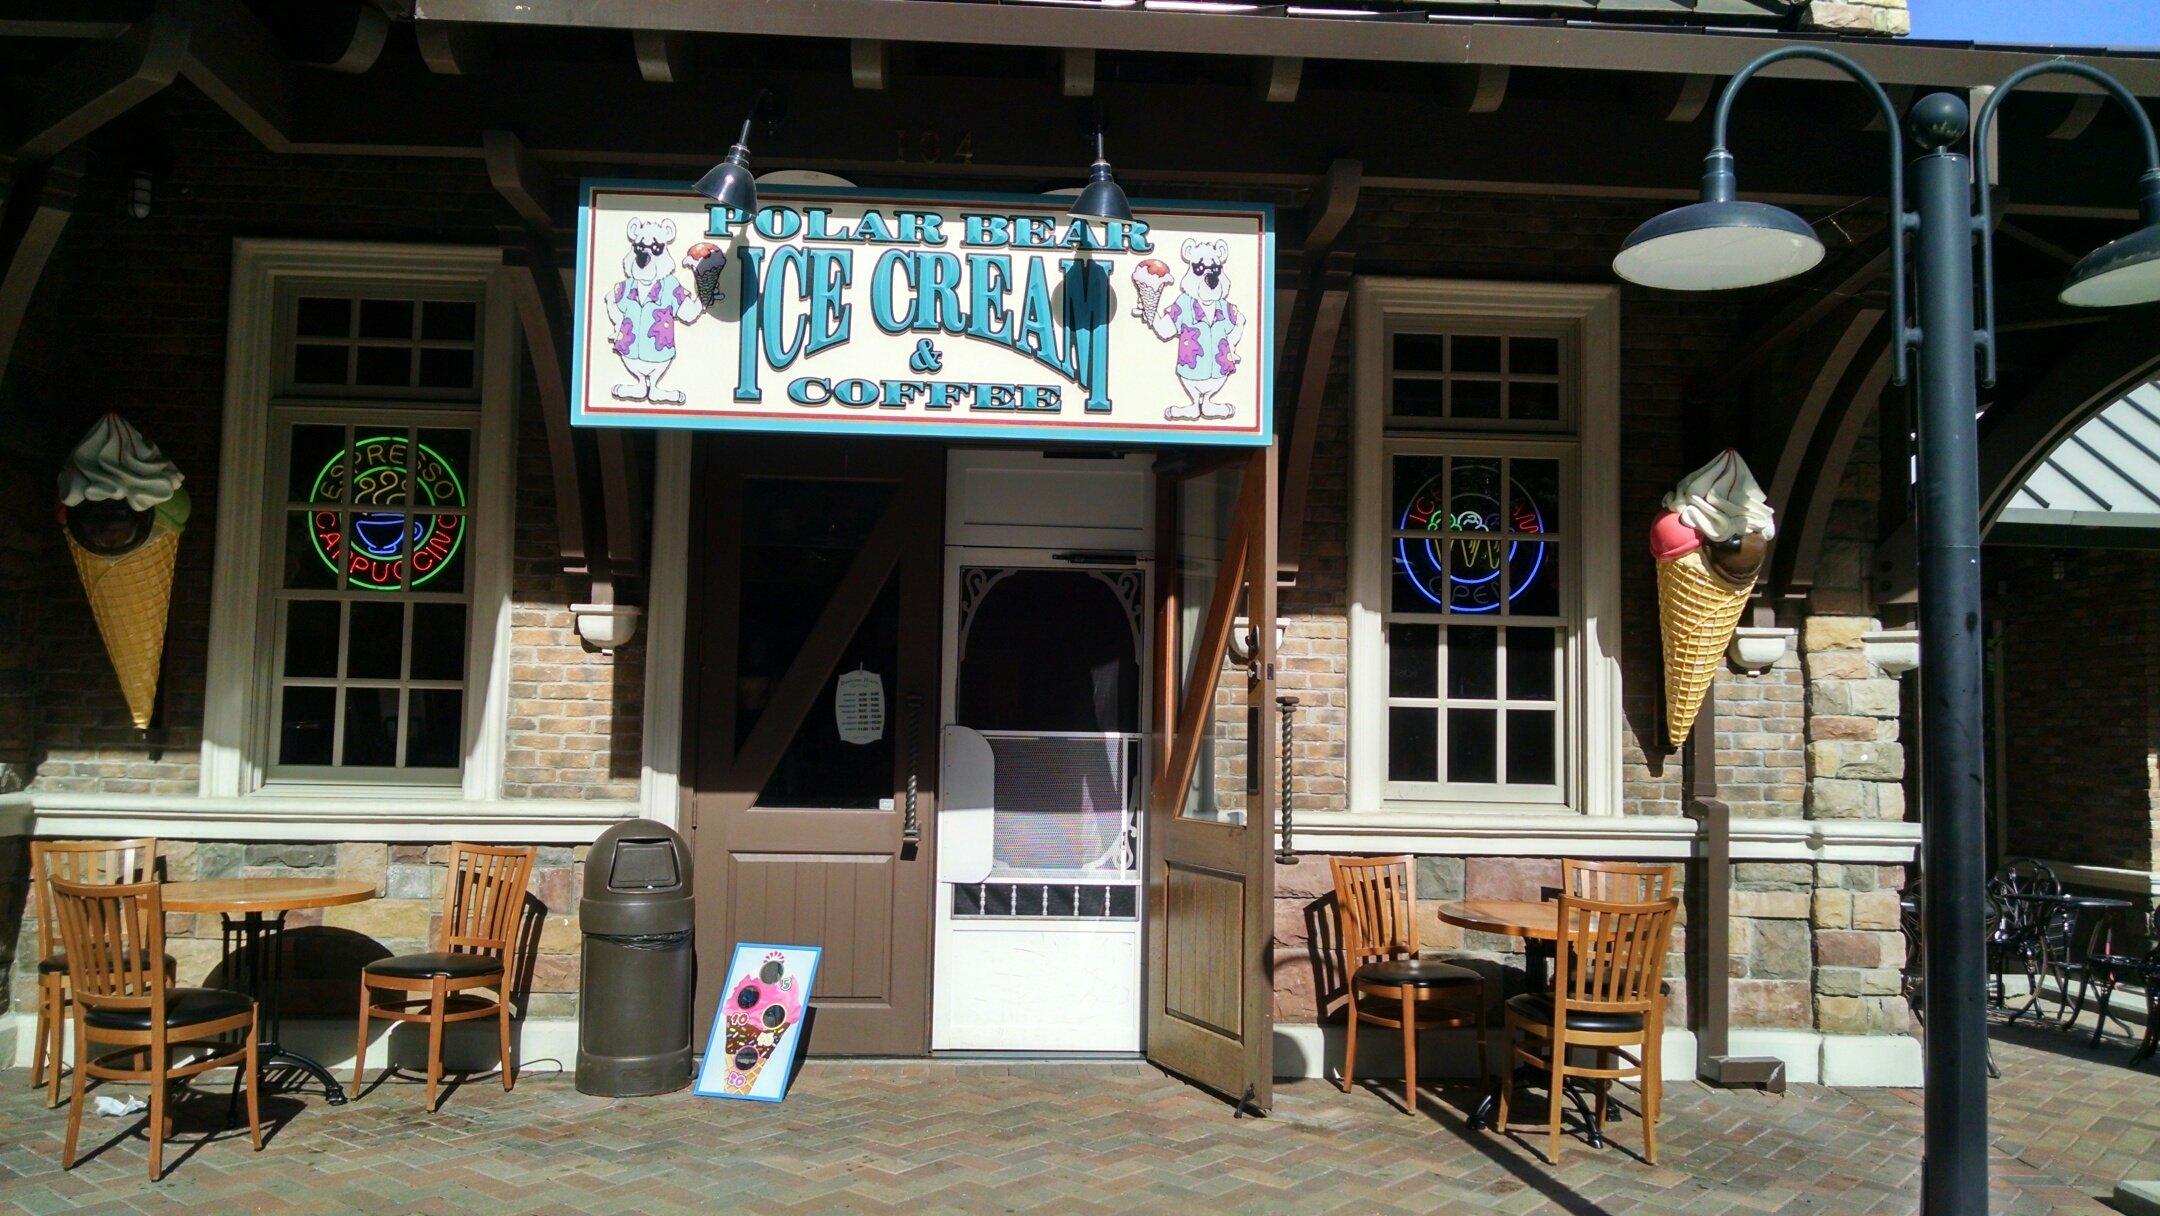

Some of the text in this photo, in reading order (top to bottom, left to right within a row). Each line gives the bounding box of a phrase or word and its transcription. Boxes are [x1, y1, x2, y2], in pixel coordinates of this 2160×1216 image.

[704, 203, 1155, 254] POLAR BEAR
[733, 244, 1113, 414] ICE CREAM
[909, 337, 942, 374] &
[787, 376, 1062, 413] COFFEE
[782, 978, 792, 990] 5
[731, 1013, 749, 1025] 10
